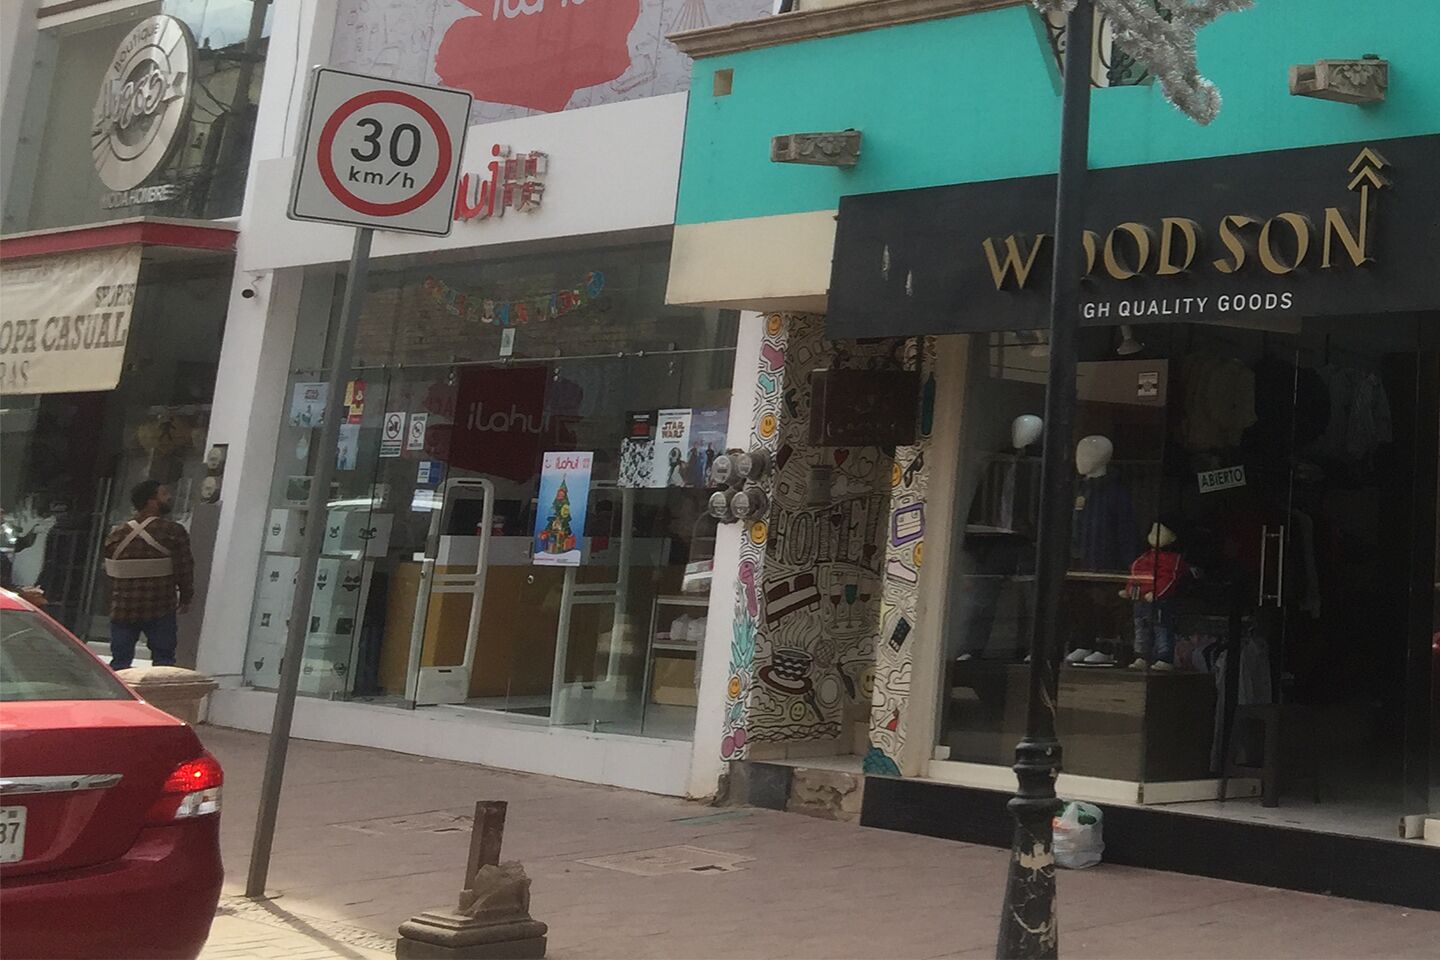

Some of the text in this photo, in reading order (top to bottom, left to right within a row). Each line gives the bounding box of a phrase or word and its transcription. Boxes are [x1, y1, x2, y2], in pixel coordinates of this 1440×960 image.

[350, 117, 422, 167] 30
[348, 165, 415, 189] km/h
[982, 185, 1370, 291] WODSON
[1118, 296, 1209, 317] QUALITY
[1217, 292, 1294, 312] GOODS
[41, 311, 127, 351] CASUAL
